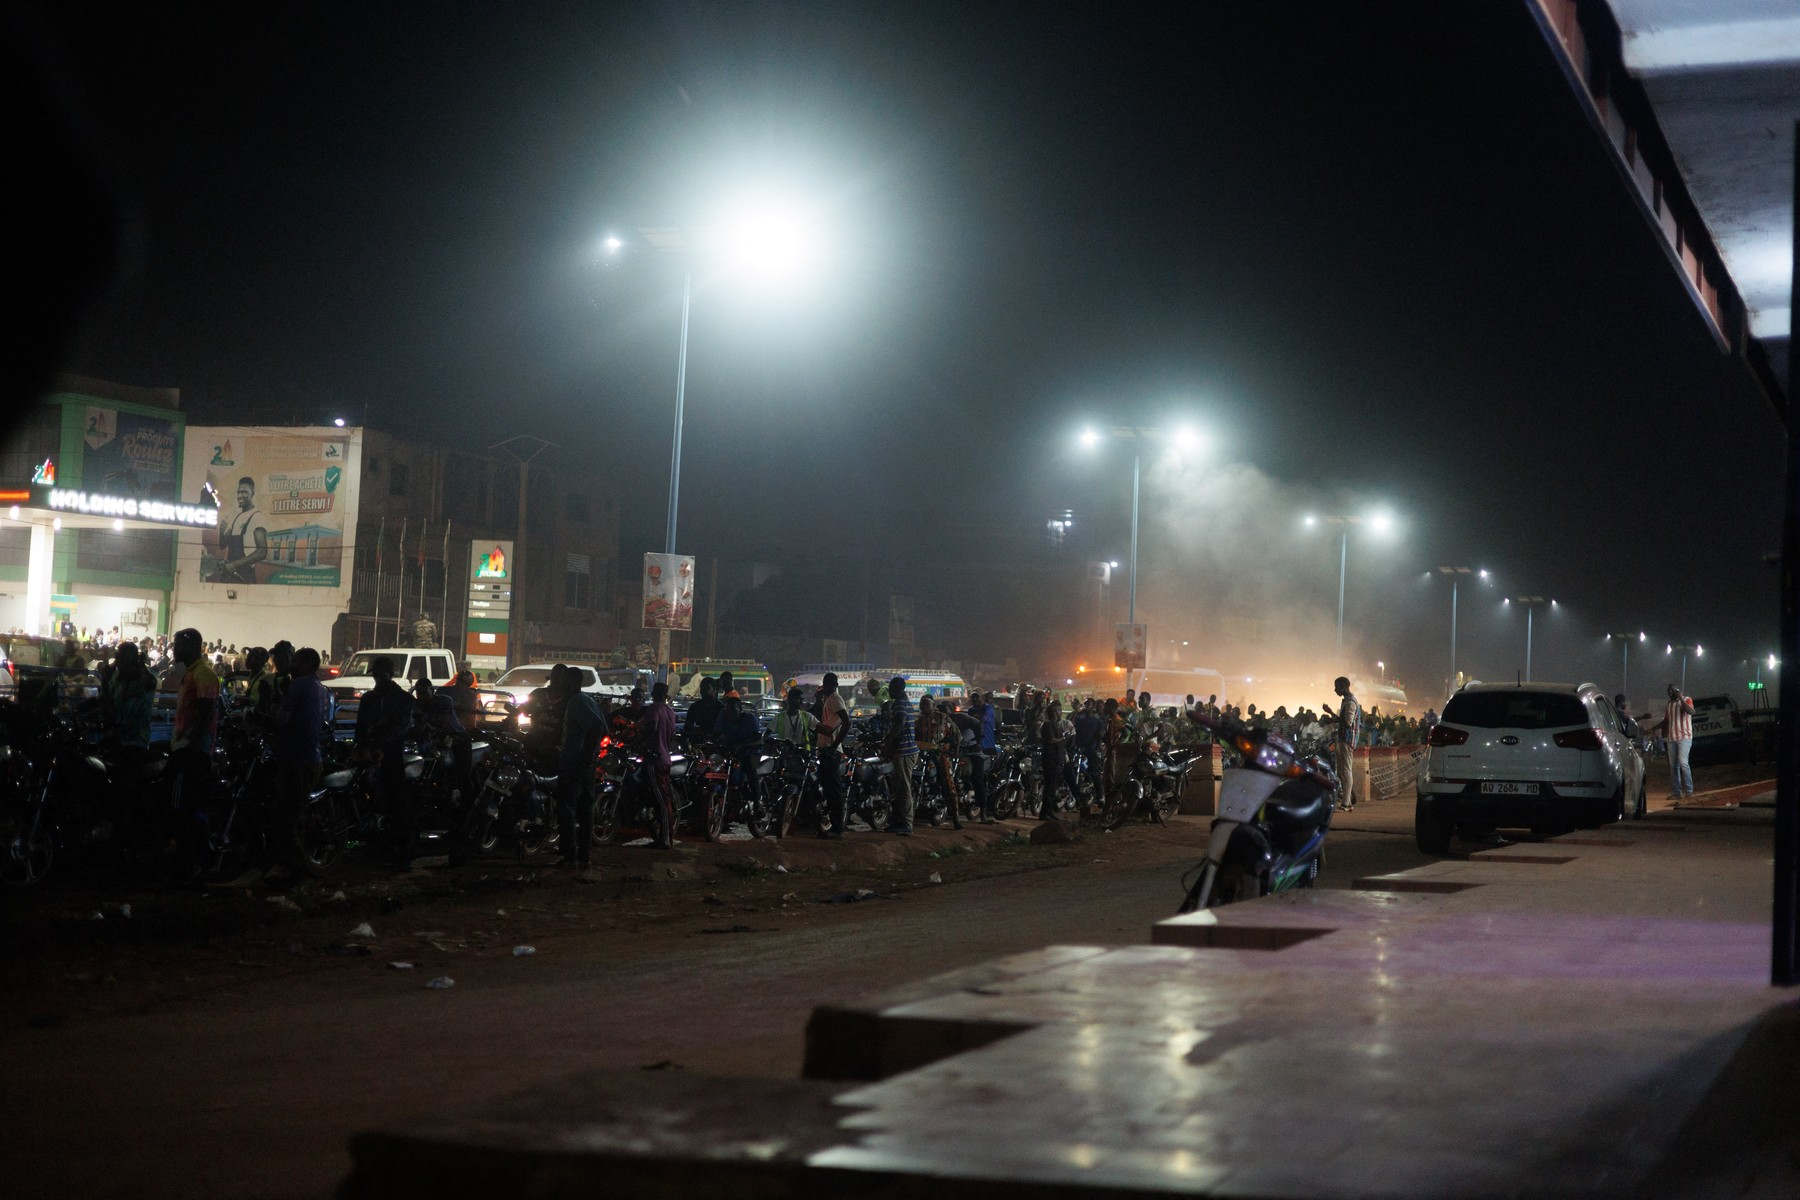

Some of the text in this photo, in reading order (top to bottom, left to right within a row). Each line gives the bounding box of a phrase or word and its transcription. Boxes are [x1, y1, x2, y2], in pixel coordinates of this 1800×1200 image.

[50, 489, 217, 526] HOLDING SERVICE
[279, 499, 300, 512] LITRE
[302, 498, 325, 511] SERVI
